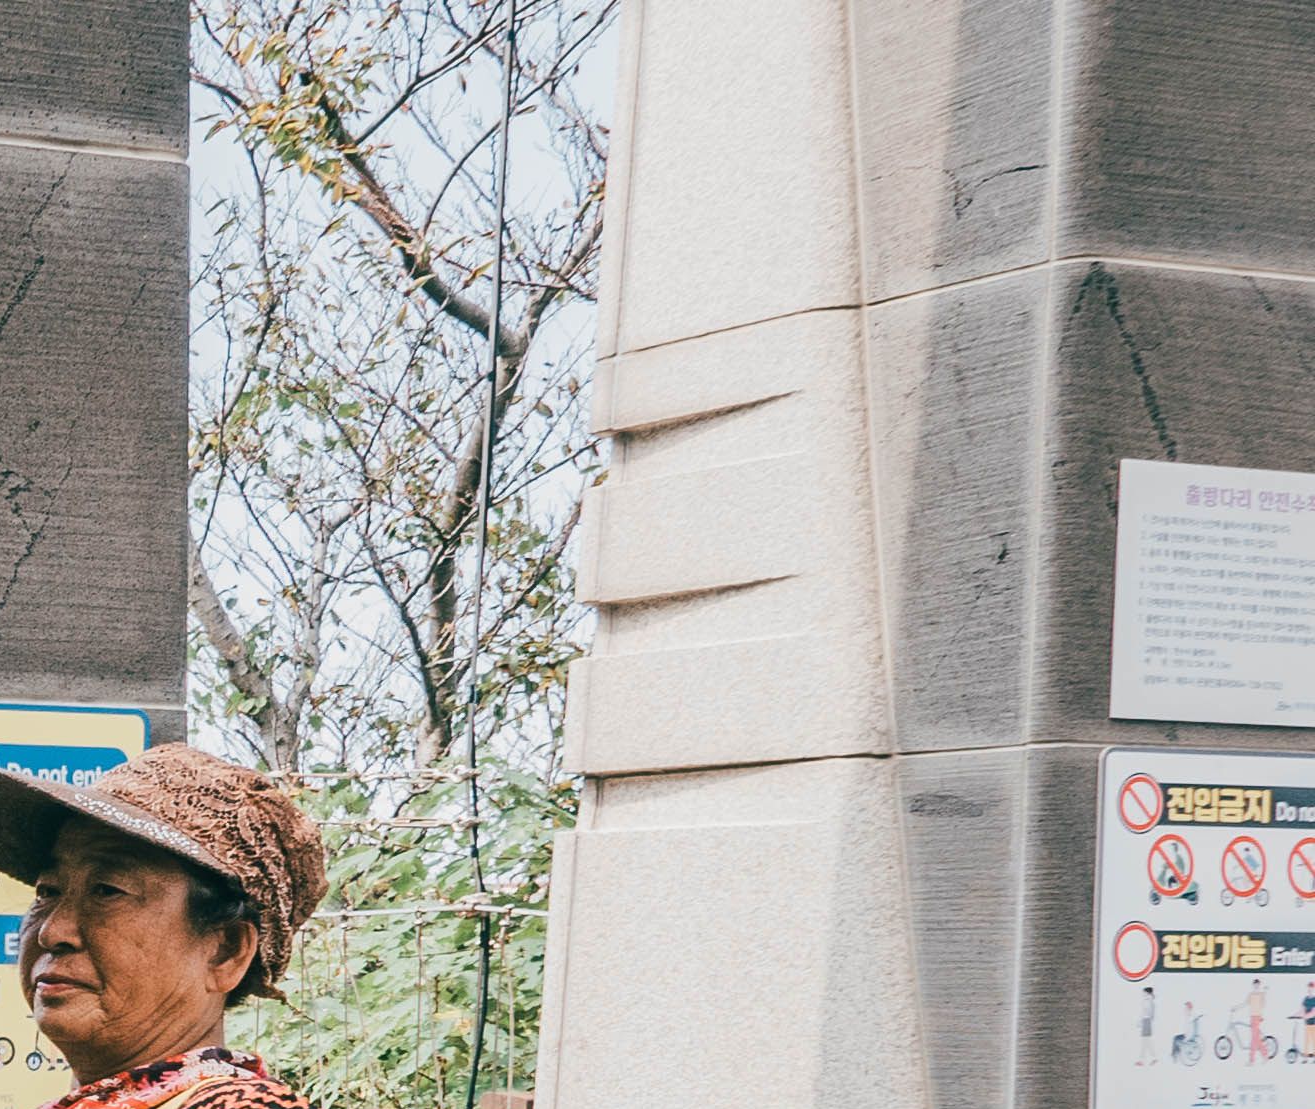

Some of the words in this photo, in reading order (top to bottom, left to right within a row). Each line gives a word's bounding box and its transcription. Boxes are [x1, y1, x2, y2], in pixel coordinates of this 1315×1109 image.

[1186, 484, 1251, 509] 출렁다리
[1167, 787, 1272, 823] 진입금지
[1275, 801, 1297, 822] Do
[1161, 934, 1267, 969] 진입가능
